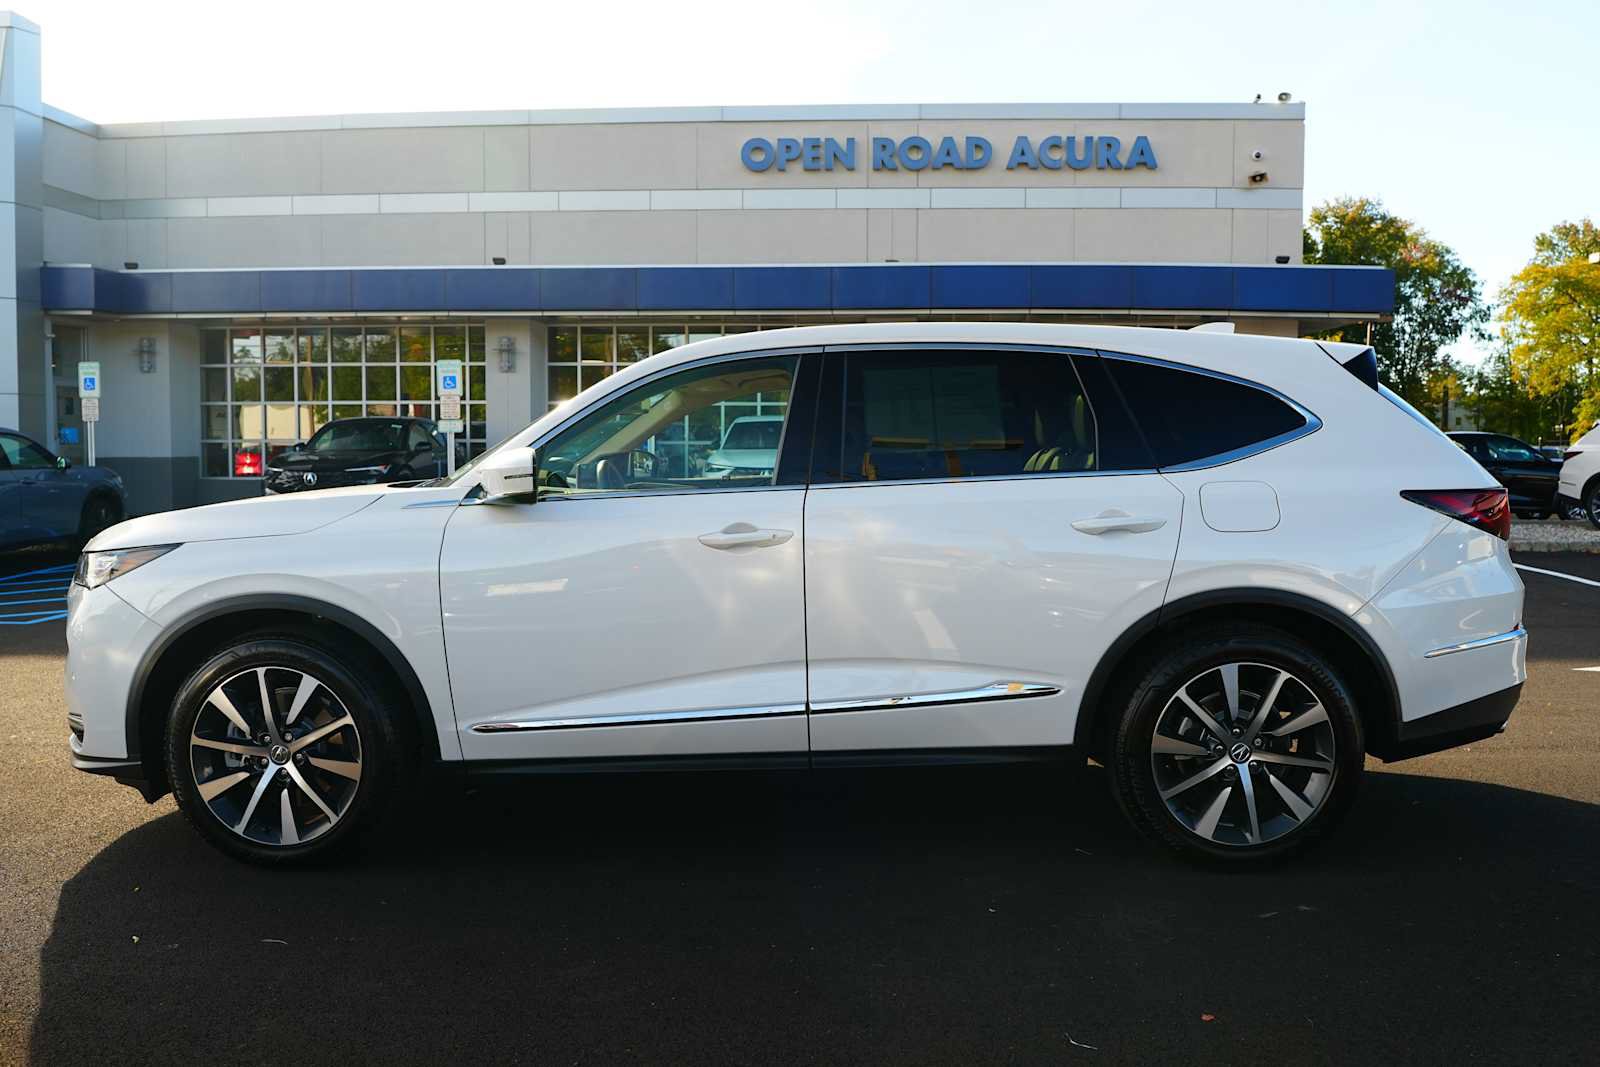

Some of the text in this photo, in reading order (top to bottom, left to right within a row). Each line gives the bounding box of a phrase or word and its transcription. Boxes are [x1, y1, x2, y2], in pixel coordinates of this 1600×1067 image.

[740, 135, 1158, 172] OPEN ROAD ACURA
